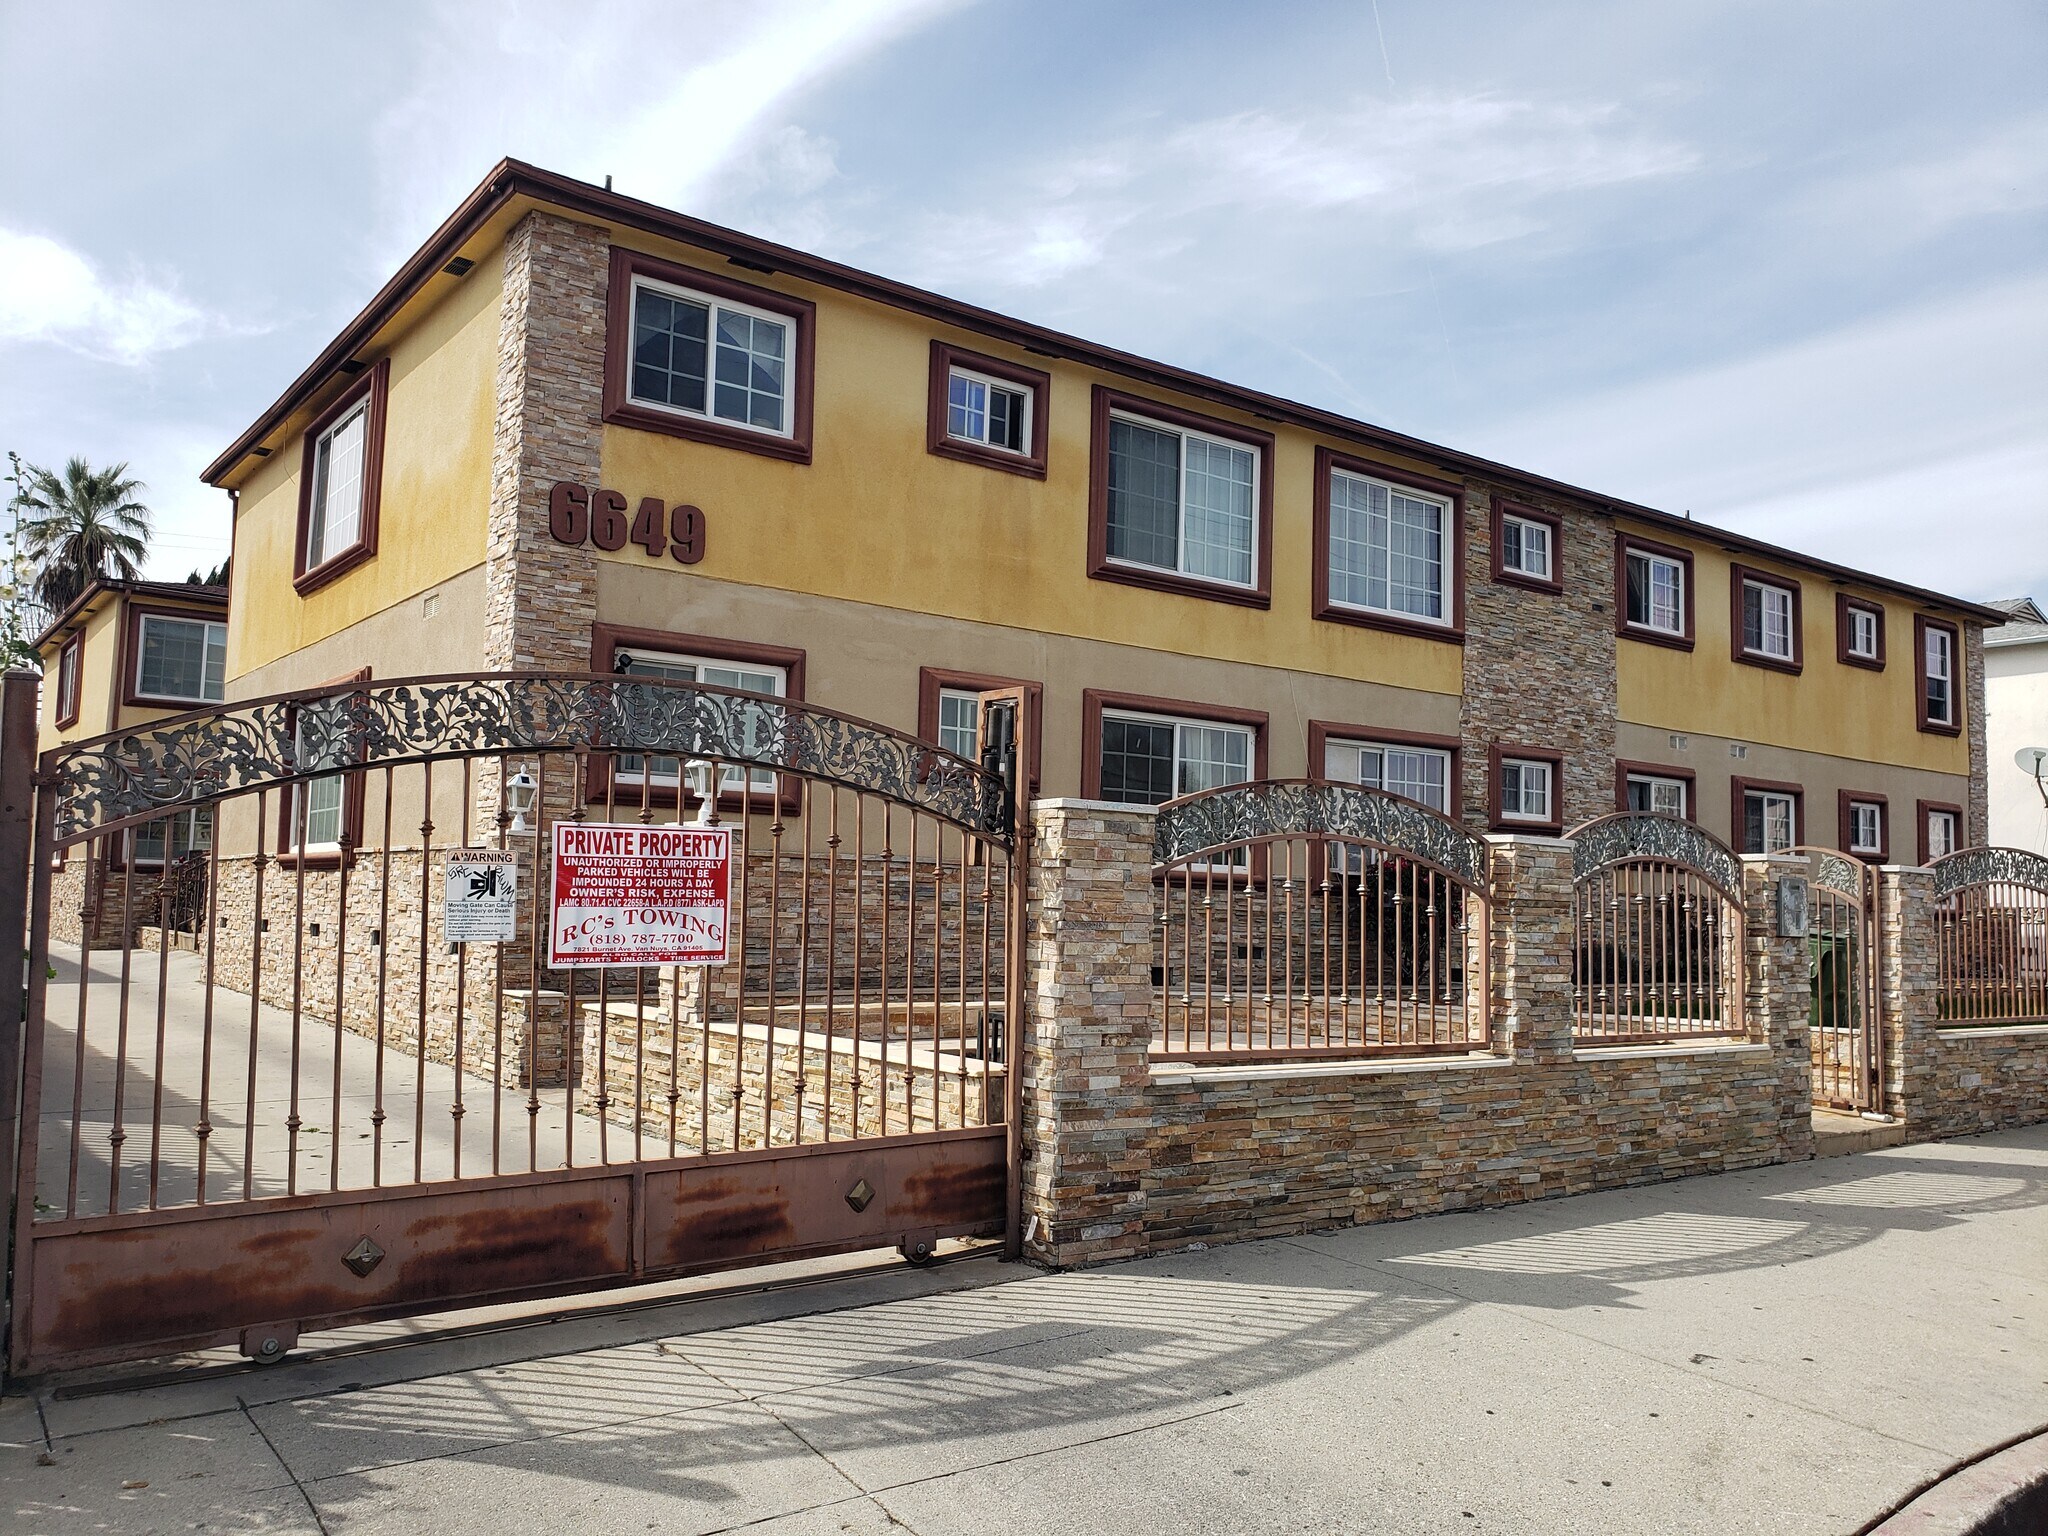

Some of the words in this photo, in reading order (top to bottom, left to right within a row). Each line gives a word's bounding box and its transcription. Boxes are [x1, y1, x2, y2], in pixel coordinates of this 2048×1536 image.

[549, 482, 705, 564] 6649
[564, 830, 633, 855] PRIVATE
[640, 832, 723, 857] PROPERTY
[461, 853, 512, 863] WARNING
[564, 858, 642, 868] UNAUTHORIZED
[647, 859, 659, 868] OR
[662, 860, 722, 869] IMPROPERLY
[578, 868, 617, 876] PARKED
[620, 868, 668, 877] VEHICLES
[671, 869, 693, 877] WILL
[697, 869, 709, 878] BE
[572, 878, 632, 887] IMPOUNDED
[636, 878, 647, 887] 24
[650, 879, 683, 887] HOURS
[686, 879, 693, 887] A
[696, 879, 713, 888] DAY
[570, 888, 624, 897] OWNER'S
[628, 888, 659, 898] RISK,
[663, 889, 715, 898] EXPENSE
[560, 898, 579, 906] LAMC
[581, 898, 605, 907] 80.71.4
[608, 899, 622, 907] CVC
[623, 899, 649, 907] 22658-A
[675, 899, 691, 908] (877)
[692, 899, 724, 907] ASK-LAPD
[561, 914, 614, 946] RC's
[623, 909, 722, 943] TOWING
[590, 935, 626, 945] (818)
[632, 934, 693, 944] 787-7700
